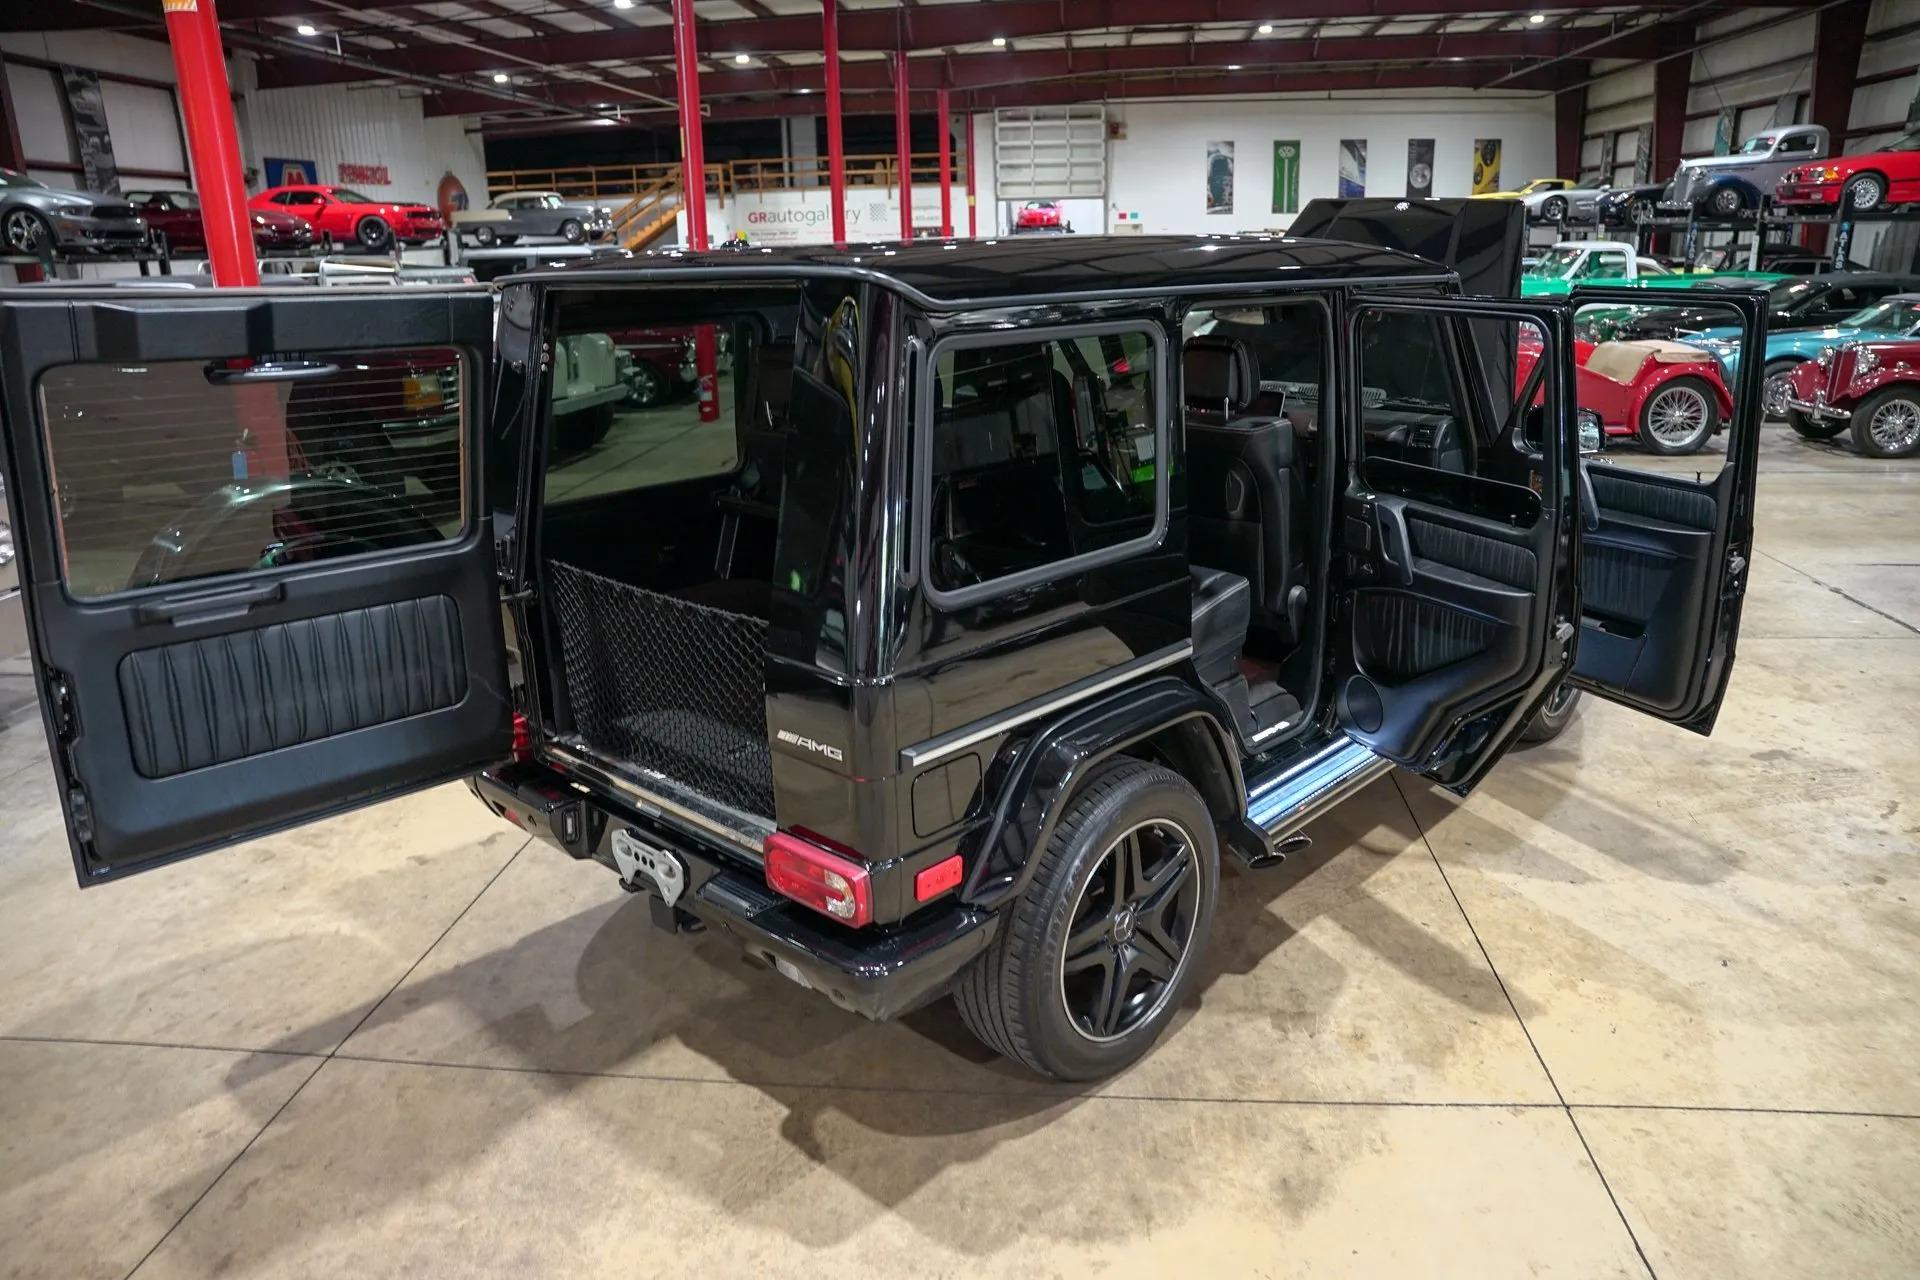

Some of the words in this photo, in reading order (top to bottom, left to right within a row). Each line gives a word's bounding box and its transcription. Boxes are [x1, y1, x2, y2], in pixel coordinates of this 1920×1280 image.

[748, 204, 861, 226] GRautogalry
[1835, 231, 1848, 269] ATLAS
[797, 736, 843, 762] AMG
